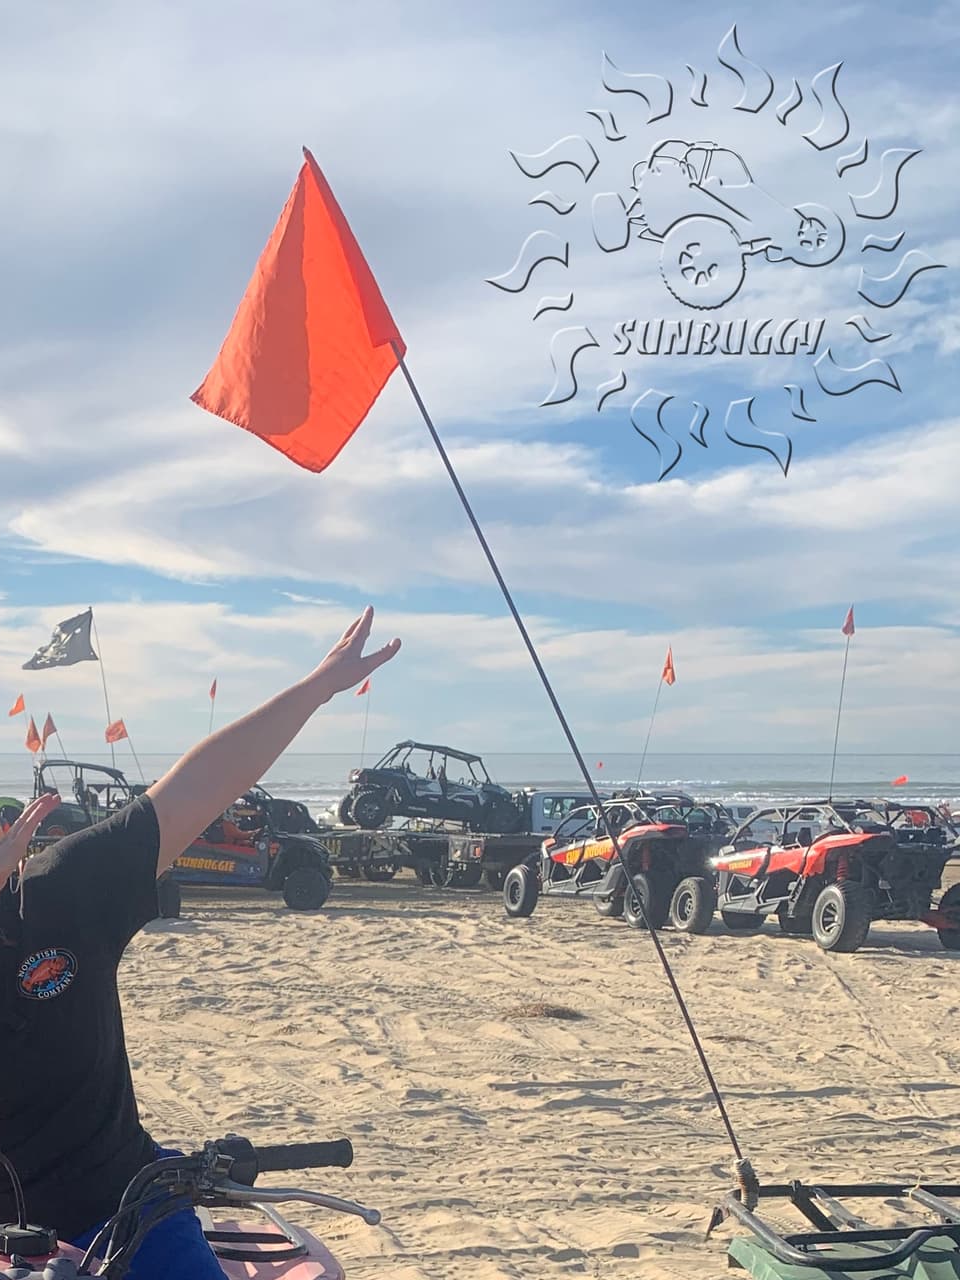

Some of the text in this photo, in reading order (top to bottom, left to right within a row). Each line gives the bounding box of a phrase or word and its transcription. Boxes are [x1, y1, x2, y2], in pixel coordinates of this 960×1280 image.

[176, 856, 236, 873] SUNBUGGIE
[17, 949, 58, 978] NOYO FISH
[37, 971, 74, 999] COMPANY
